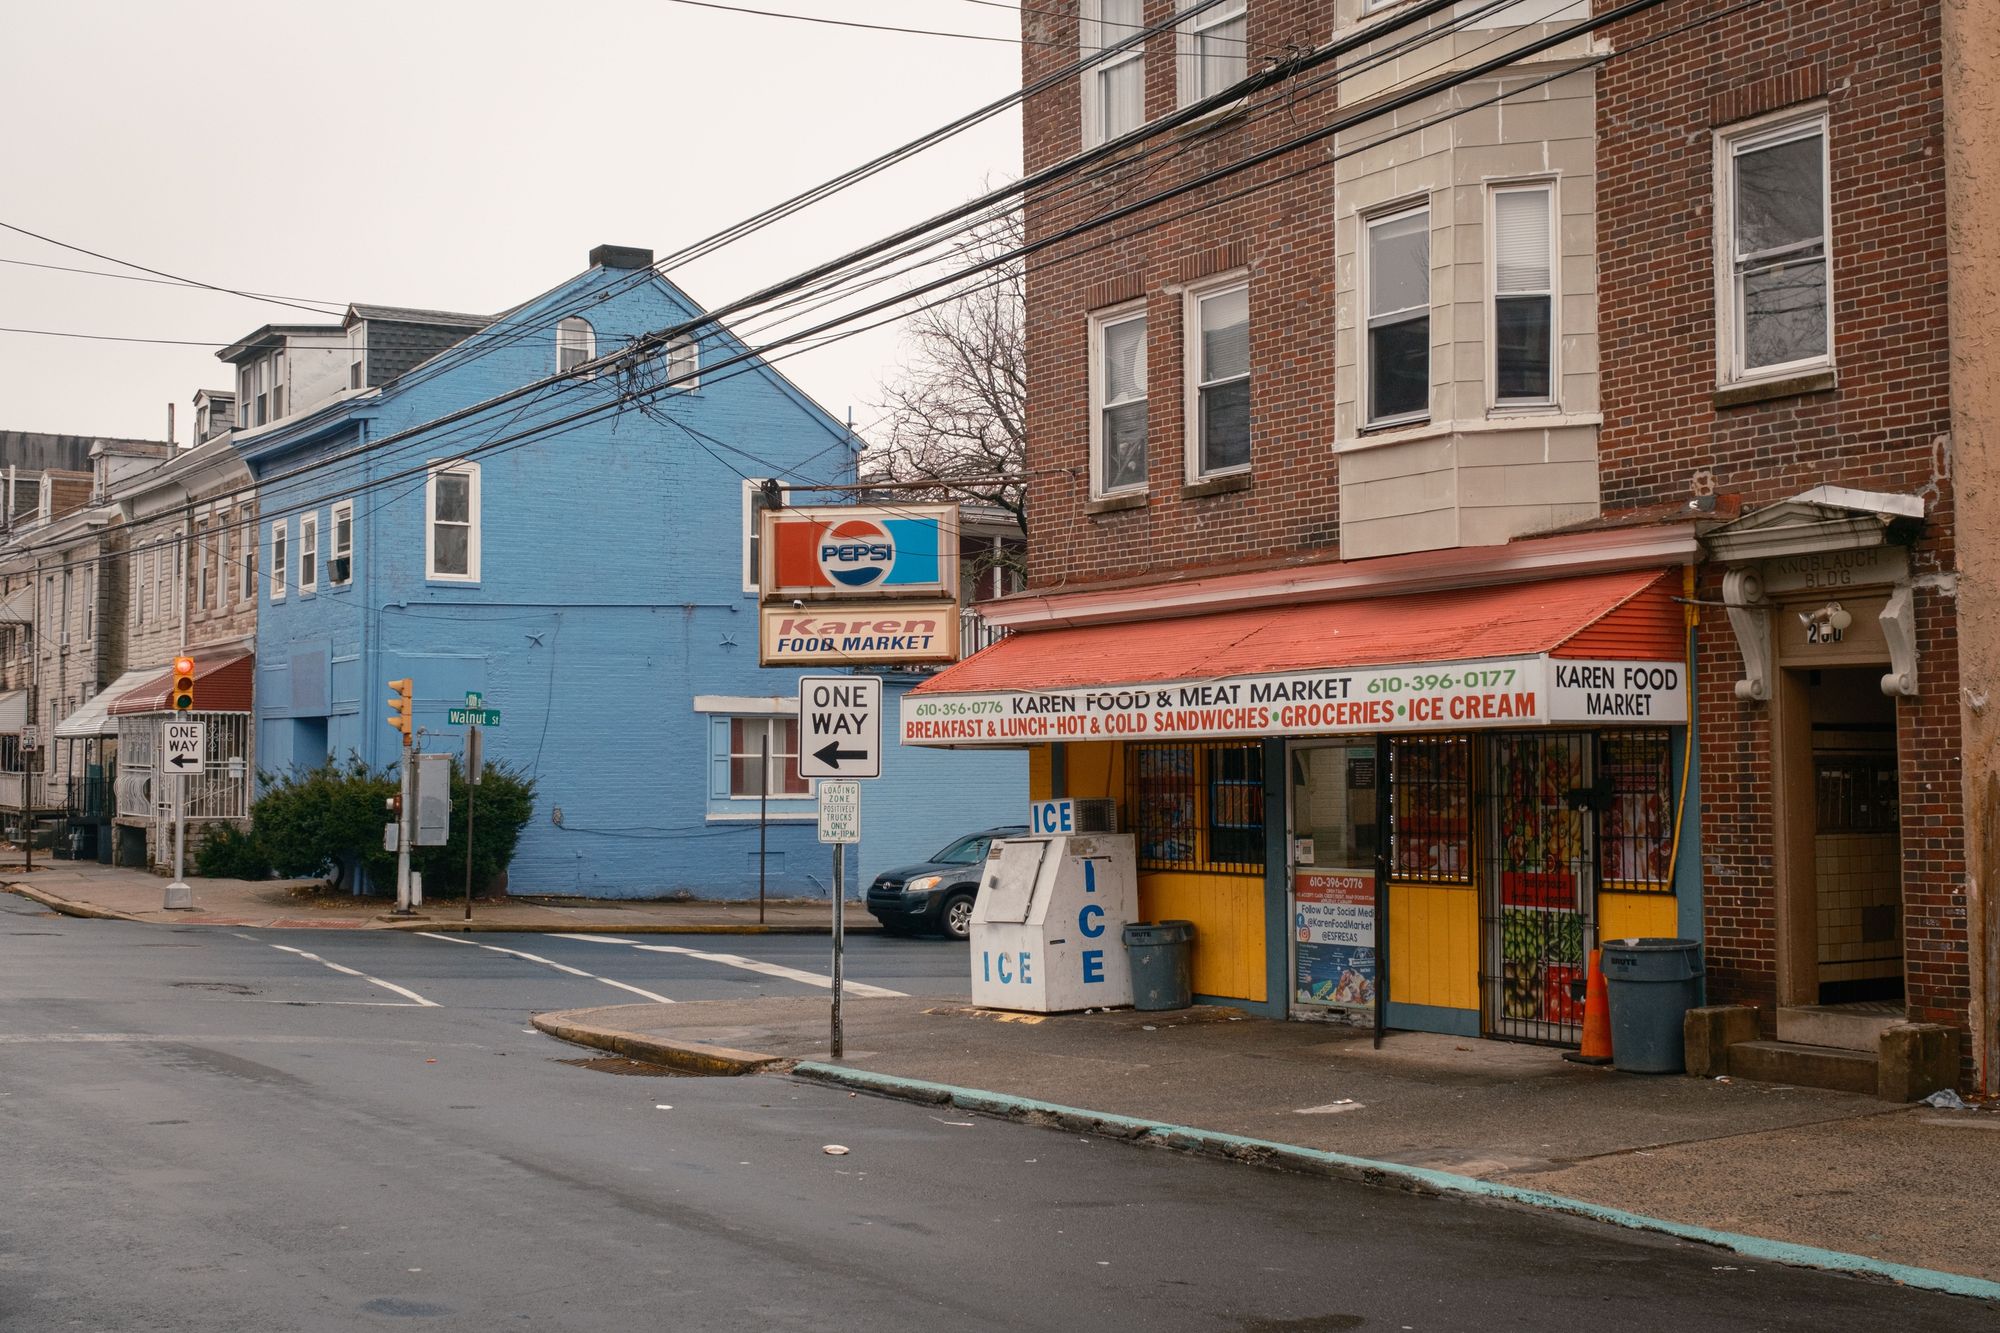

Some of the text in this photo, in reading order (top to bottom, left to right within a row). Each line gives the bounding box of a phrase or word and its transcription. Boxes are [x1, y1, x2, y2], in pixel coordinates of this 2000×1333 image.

[822, 544, 892, 562] PEPSI
[1778, 549, 1878, 575] KNOBLAUCH
[778, 618, 936, 636] Karen
[778, 635, 933, 652] FOOD MARKET
[1556, 665, 1678, 691] KAREN FOOD
[813, 685, 868, 708] ONE
[1013, 695, 1076, 715] KAREN
[1086, 690, 1150, 712] FOOD
[1157, 689, 1172, 707] &
[1179, 685, 1241, 706] MEAT
[1250, 678, 1352, 703] MARKET
[1587, 693, 1652, 716] MARKET
[450, 710, 499, 725] Walnut St
[812, 713, 868, 735] WAY
[906, 719, 983, 739] BREAKFAST
[987, 720, 997, 737] &
[1090, 717, 1100, 734] &
[1105, 711, 1147, 734] COLD
[1450, 692, 1536, 721] CREAM
[169, 726, 198, 738] ONE
[168, 740, 199, 752] WAY
[824, 786, 856, 794] LOADING
[829, 795, 850, 803] ZONE
[824, 805, 855, 813] POSITIVELY
[827, 813, 852, 821] TRUCKS
[1033, 802, 1072, 833] ICE
[831, 822, 847, 830] ONLY
[1309, 876, 1363, 889] 610-396-0776
[1302, 904, 1375, 918] Follow Our Social Medi
[1078, 860, 1105, 984] ICE
[1307, 918, 1372, 931] @KarenFoodMarket
[1322, 931, 1358, 943] @ESFRESAS
[983, 951, 1032, 984] ICE
